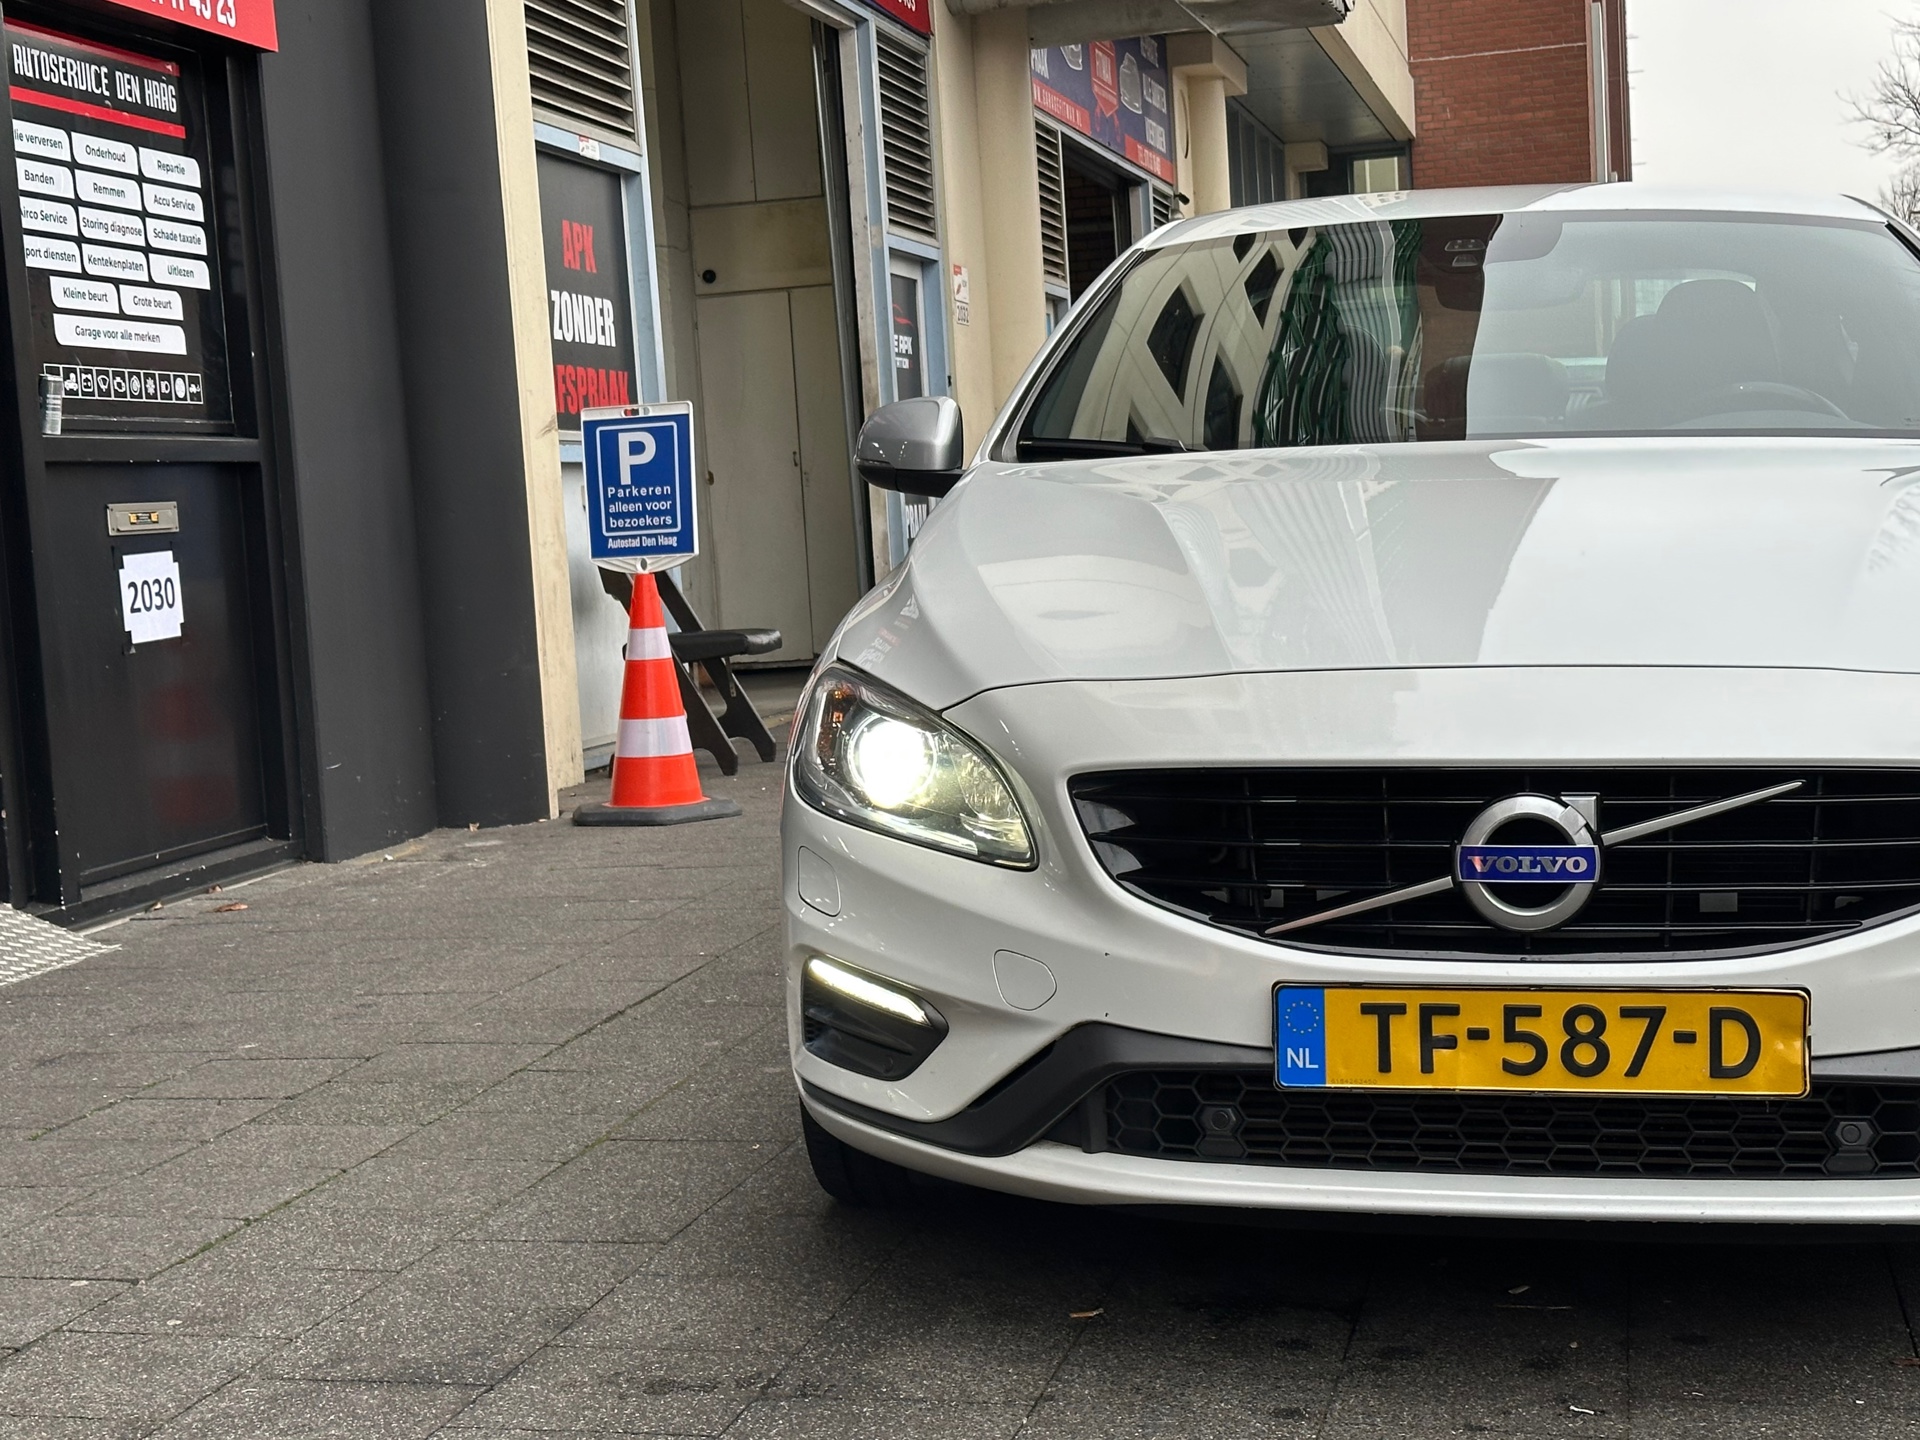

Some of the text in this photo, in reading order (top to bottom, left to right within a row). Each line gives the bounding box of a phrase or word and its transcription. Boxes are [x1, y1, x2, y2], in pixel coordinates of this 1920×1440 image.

[12, 44, 177, 113] AUTOSERVICE DEN HAAG
[14, 128, 63, 149] lie verversen
[85, 144, 126, 163] Onderhoud
[157, 160, 186, 176] Repartie
[24, 169, 55, 186] Banden
[93, 182, 126, 199] Remmen
[154, 194, 196, 212] Accu Service
[40, 209, 68, 225] Service
[82, 217, 143, 237] Storing diagnose
[153, 228, 201, 246] Schade taxatie
[562, 219, 597, 273] APK
[44, 247, 77, 263] diensten
[88, 254, 144, 273] Kentekenplaten
[167, 264, 195, 279] Uitlezen
[63, 286, 109, 303] Kleine beurt
[133, 295, 172, 310] Grote beurt
[551, 290, 616, 347] ZONDER
[75, 325, 161, 344] Garage voor alle merken
[554, 364, 632, 415] FSPRAAK
[618, 431, 657, 486] P
[608, 485, 671, 499] Parkeren
[609, 500, 672, 513] alleen voor
[610, 515, 672, 529] bezoekers
[608, 535, 678, 549] Autostad Den Haag
[128, 577, 175, 614] 2030
[1467, 855, 1588, 874] VOLVO
[1286, 1002, 1763, 1080] NL TF-587-D
